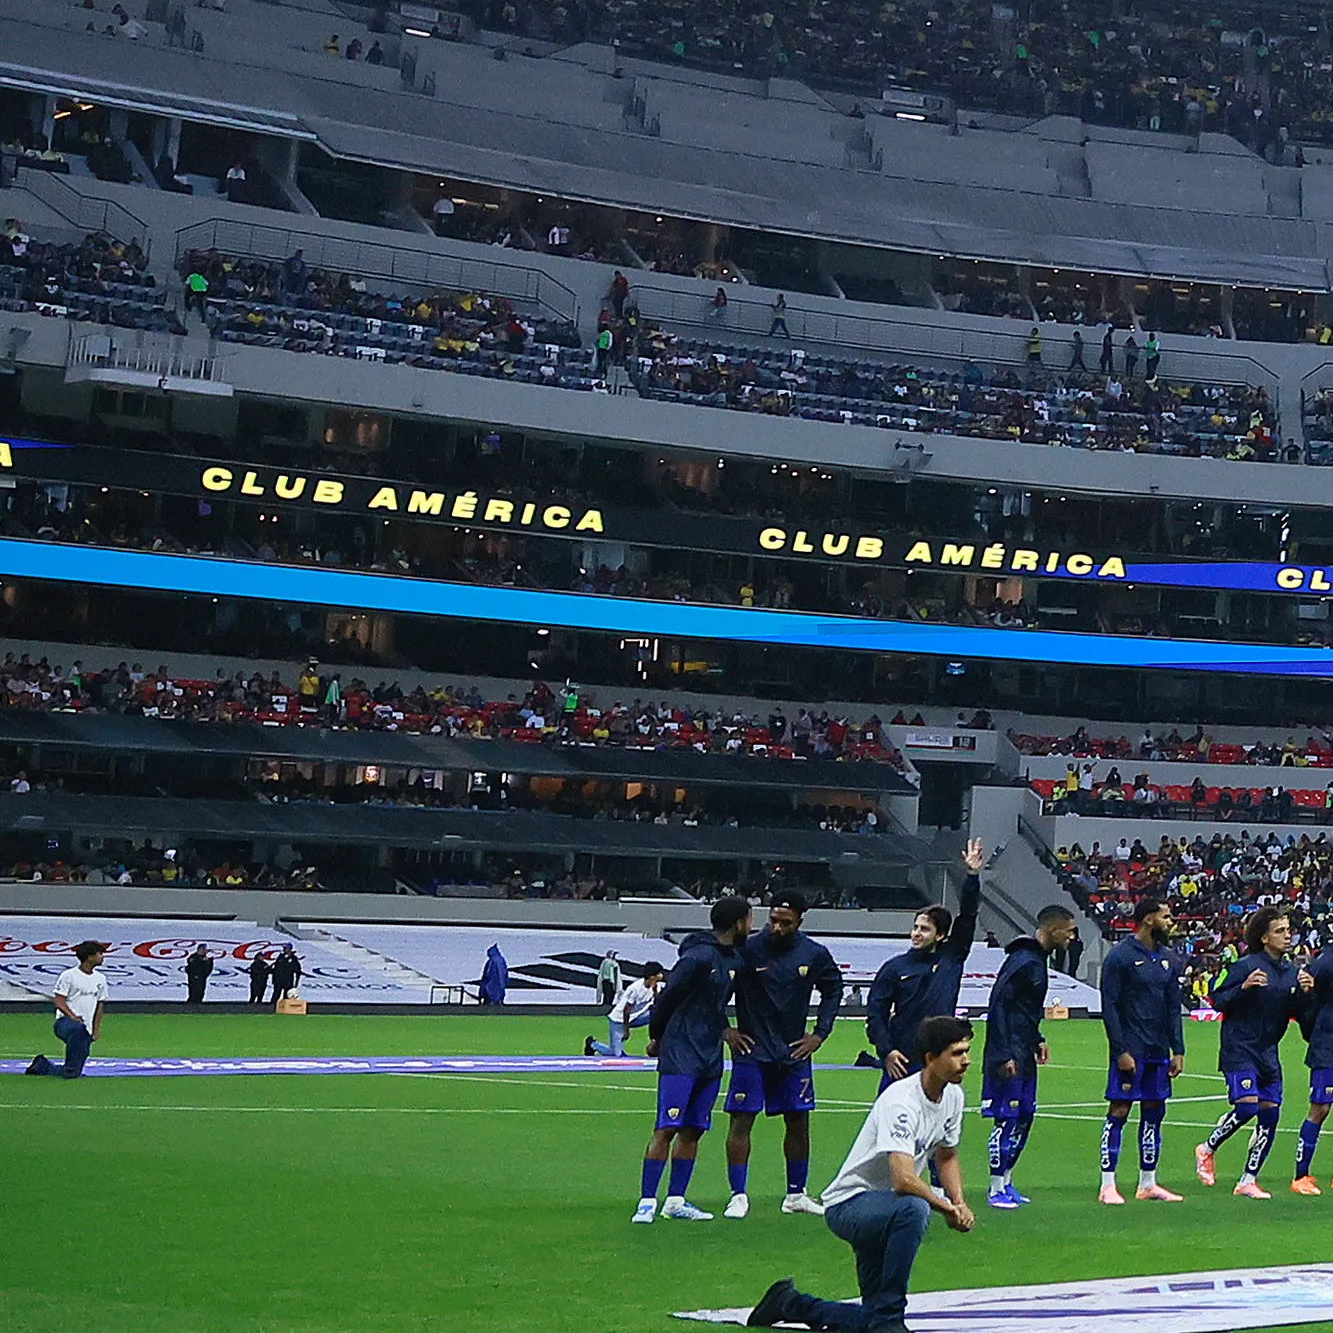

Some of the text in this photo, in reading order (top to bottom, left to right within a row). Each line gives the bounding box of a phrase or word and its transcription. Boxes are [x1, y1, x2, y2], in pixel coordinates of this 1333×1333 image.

[202, 467, 603, 532] CLUB AMÉRICA
[759, 528, 1125, 577] CLUB AMÉRICA
[1141, 1121, 1157, 1164] CREST
[1208, 1113, 1240, 1146] CREST
[1248, 1125, 1270, 1170] CREST
